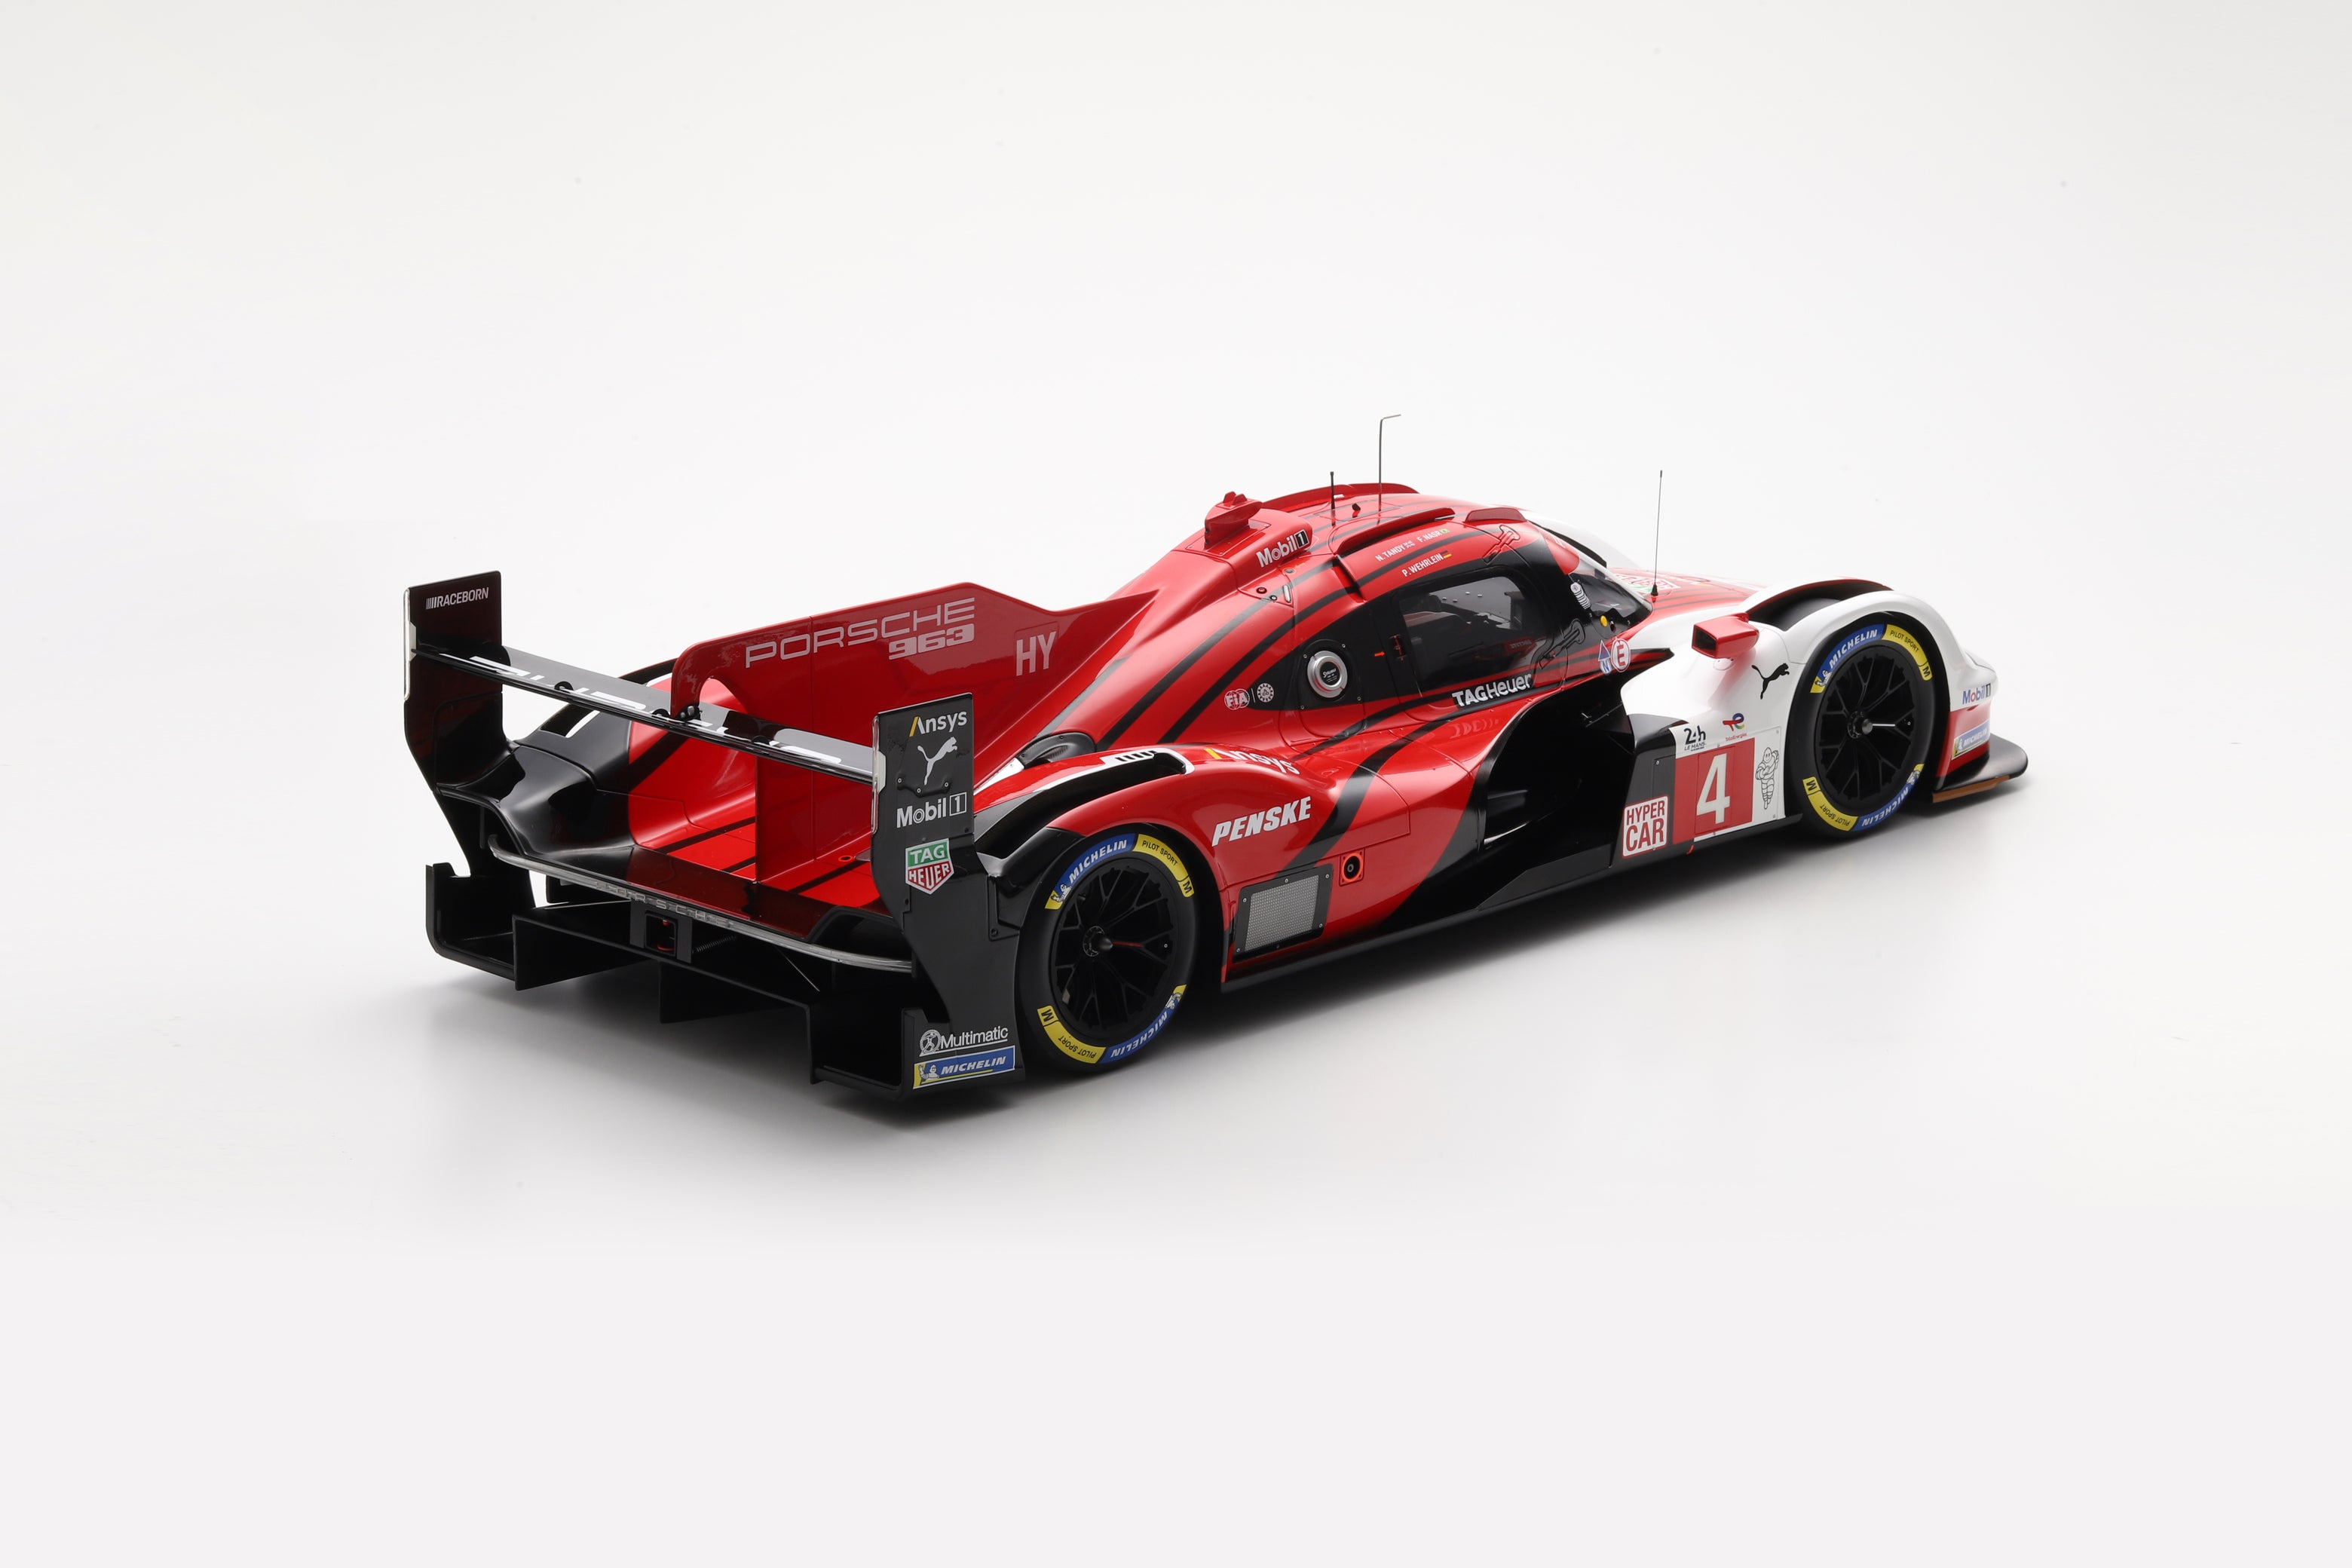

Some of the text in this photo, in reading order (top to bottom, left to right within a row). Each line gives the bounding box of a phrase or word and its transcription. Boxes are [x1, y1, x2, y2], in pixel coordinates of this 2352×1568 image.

[1256, 534, 1297, 568] Mobil
[436, 586, 489, 608] RACEBORN
[746, 597, 975, 668] PORSCHE
[889, 623, 975, 660] 963
[1890, 629, 1919, 653] PILOT SPORT
[1015, 631, 1056, 676] HY
[1829, 629, 1878, 669] MICHELIN
[1962, 684, 1986, 705] Mobil
[909, 711, 967, 737] Ansys
[1683, 725, 1706, 745] 24h
[1697, 753, 1730, 825] 4
[896, 797, 947, 828] Mobil
[1626, 800, 1664, 825] HYPER
[1861, 786, 1909, 827] MICHELIN
[1211, 796, 1311, 847] PENSKE
[1625, 818, 1664, 852] CAR
[909, 844, 945, 865] TAG
[1069, 840, 1127, 884] MICHELIN
[1142, 840, 1178, 866] PILOT SPORT
[908, 865, 951, 890] HEUER
[941, 1026, 1009, 1049] Multimatic
[1058, 1036, 1097, 1059] PILOT SPORT
[1110, 1011, 1168, 1058] MICHELIN
[941, 1056, 1006, 1075] MICHELIN
